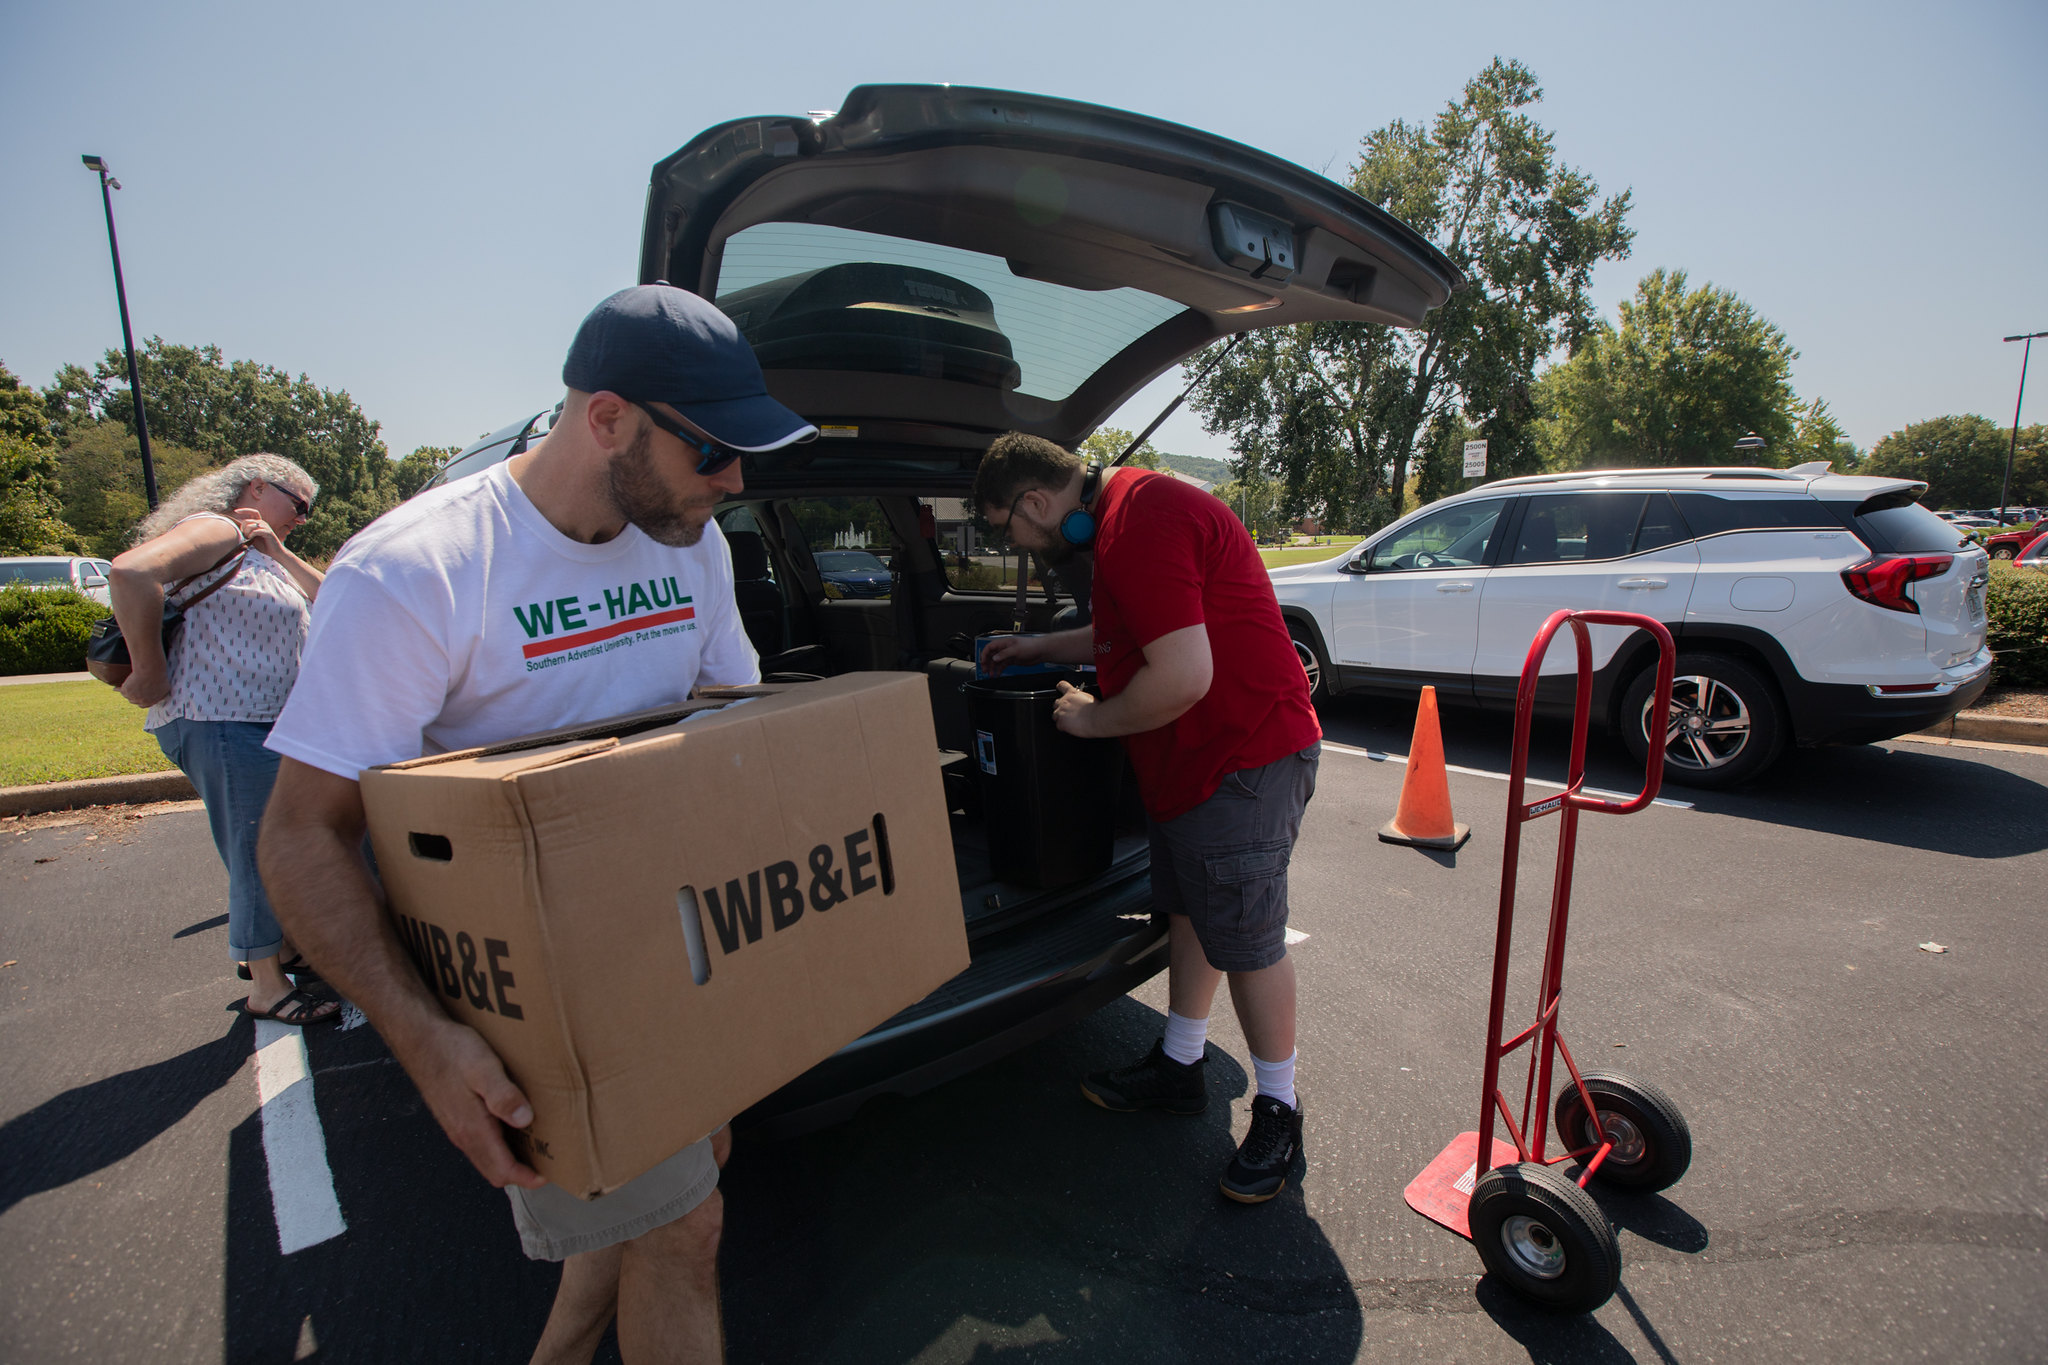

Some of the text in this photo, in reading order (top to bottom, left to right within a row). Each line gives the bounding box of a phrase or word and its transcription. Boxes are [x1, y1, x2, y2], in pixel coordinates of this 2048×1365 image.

[1465, 443, 1486, 451] 2500N
[513, 576, 693, 639] WE-HAUL
[526, 655, 566, 672] Southern
[567, 644, 603, 662] Adventist
[637, 632, 650, 642] Put
[650, 628, 661, 639] the
[662, 626, 679, 637] move
[702, 828, 877, 954] WB&E
[401, 914, 524, 1021] WB&E
